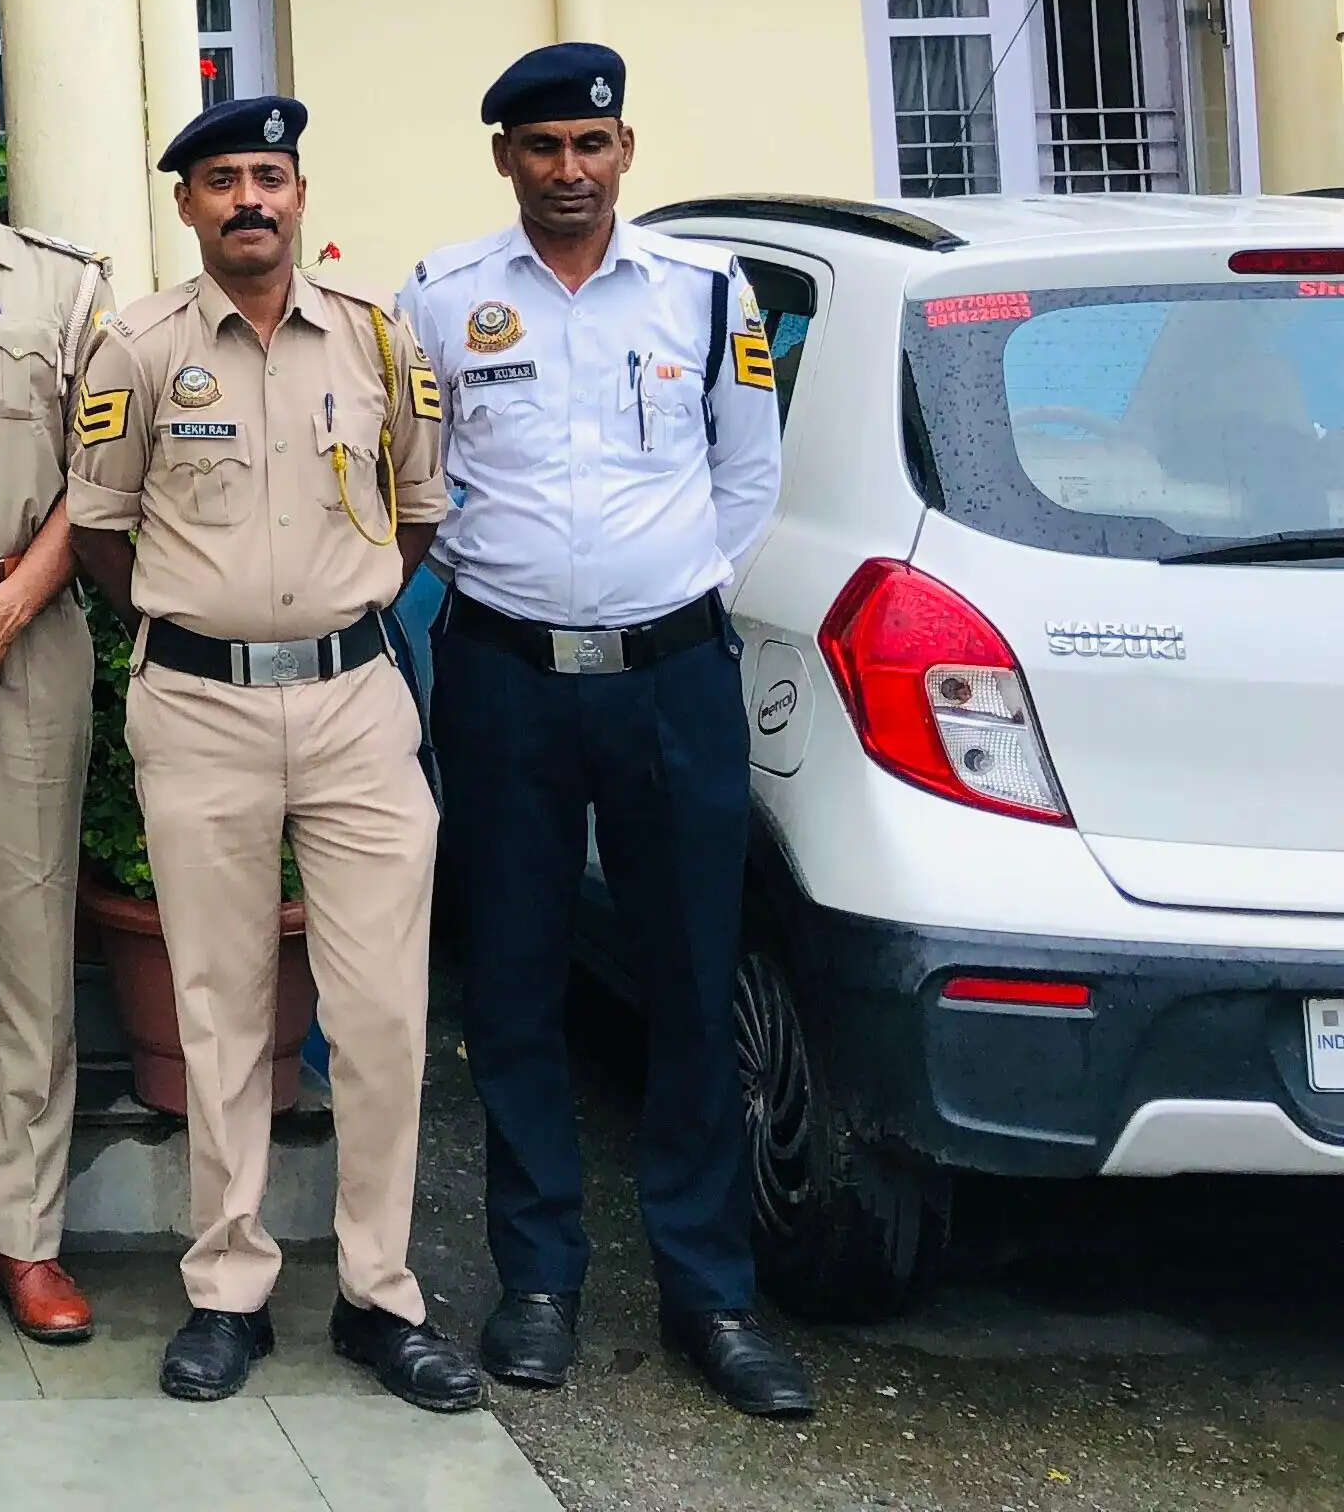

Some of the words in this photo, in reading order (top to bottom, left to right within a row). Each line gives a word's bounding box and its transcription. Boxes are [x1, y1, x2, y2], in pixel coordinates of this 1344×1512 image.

[466, 370, 488, 383] RAJ
[494, 366, 532, 380] KUMAR
[178, 424, 206, 435] LEKH
[208, 424, 229, 435] RAJ
[1045, 620, 1184, 640] MARUTI
[1048, 636, 1187, 660] SUZUKI
